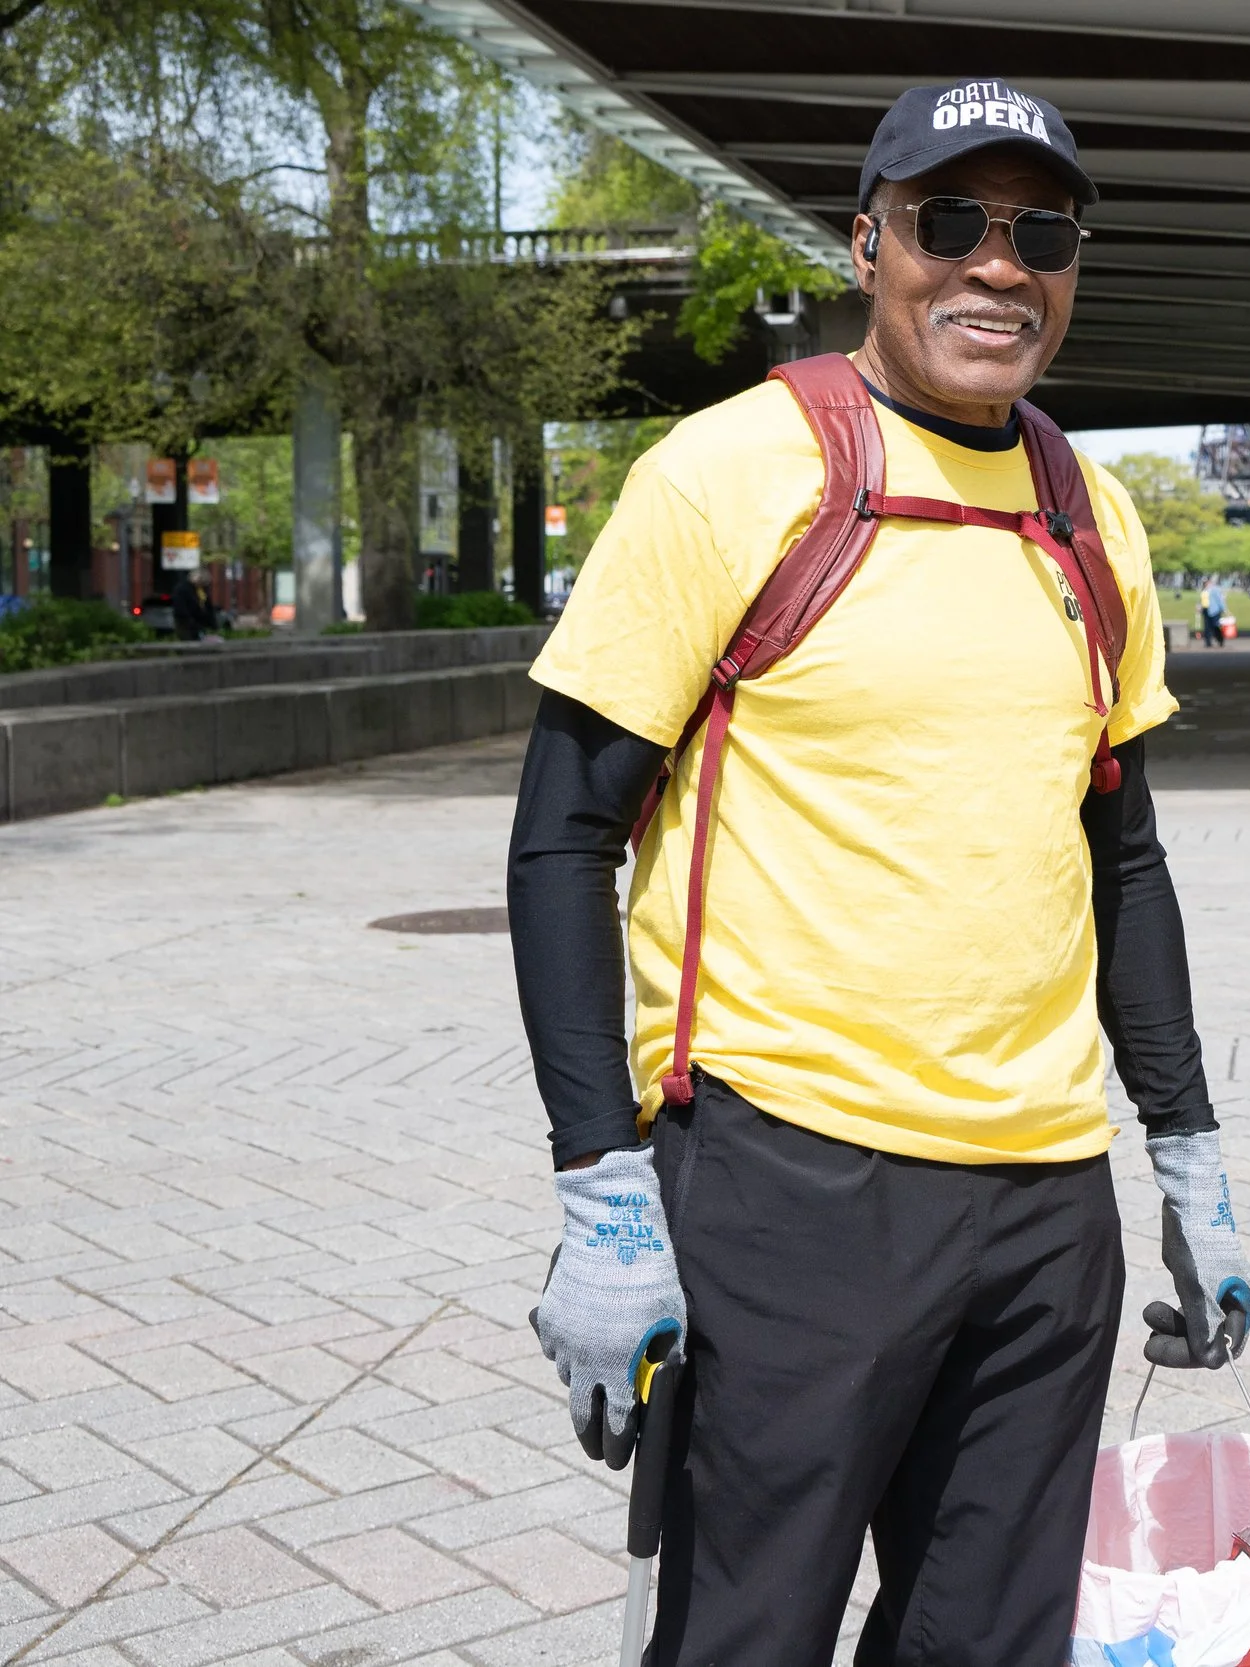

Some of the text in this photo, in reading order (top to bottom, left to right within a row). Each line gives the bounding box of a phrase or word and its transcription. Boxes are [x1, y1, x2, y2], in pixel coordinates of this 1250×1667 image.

[936, 81, 1045, 118] PORTLAND
[932, 100, 1052, 146] OPERA
[595, 1223, 654, 1238] ATLAS
